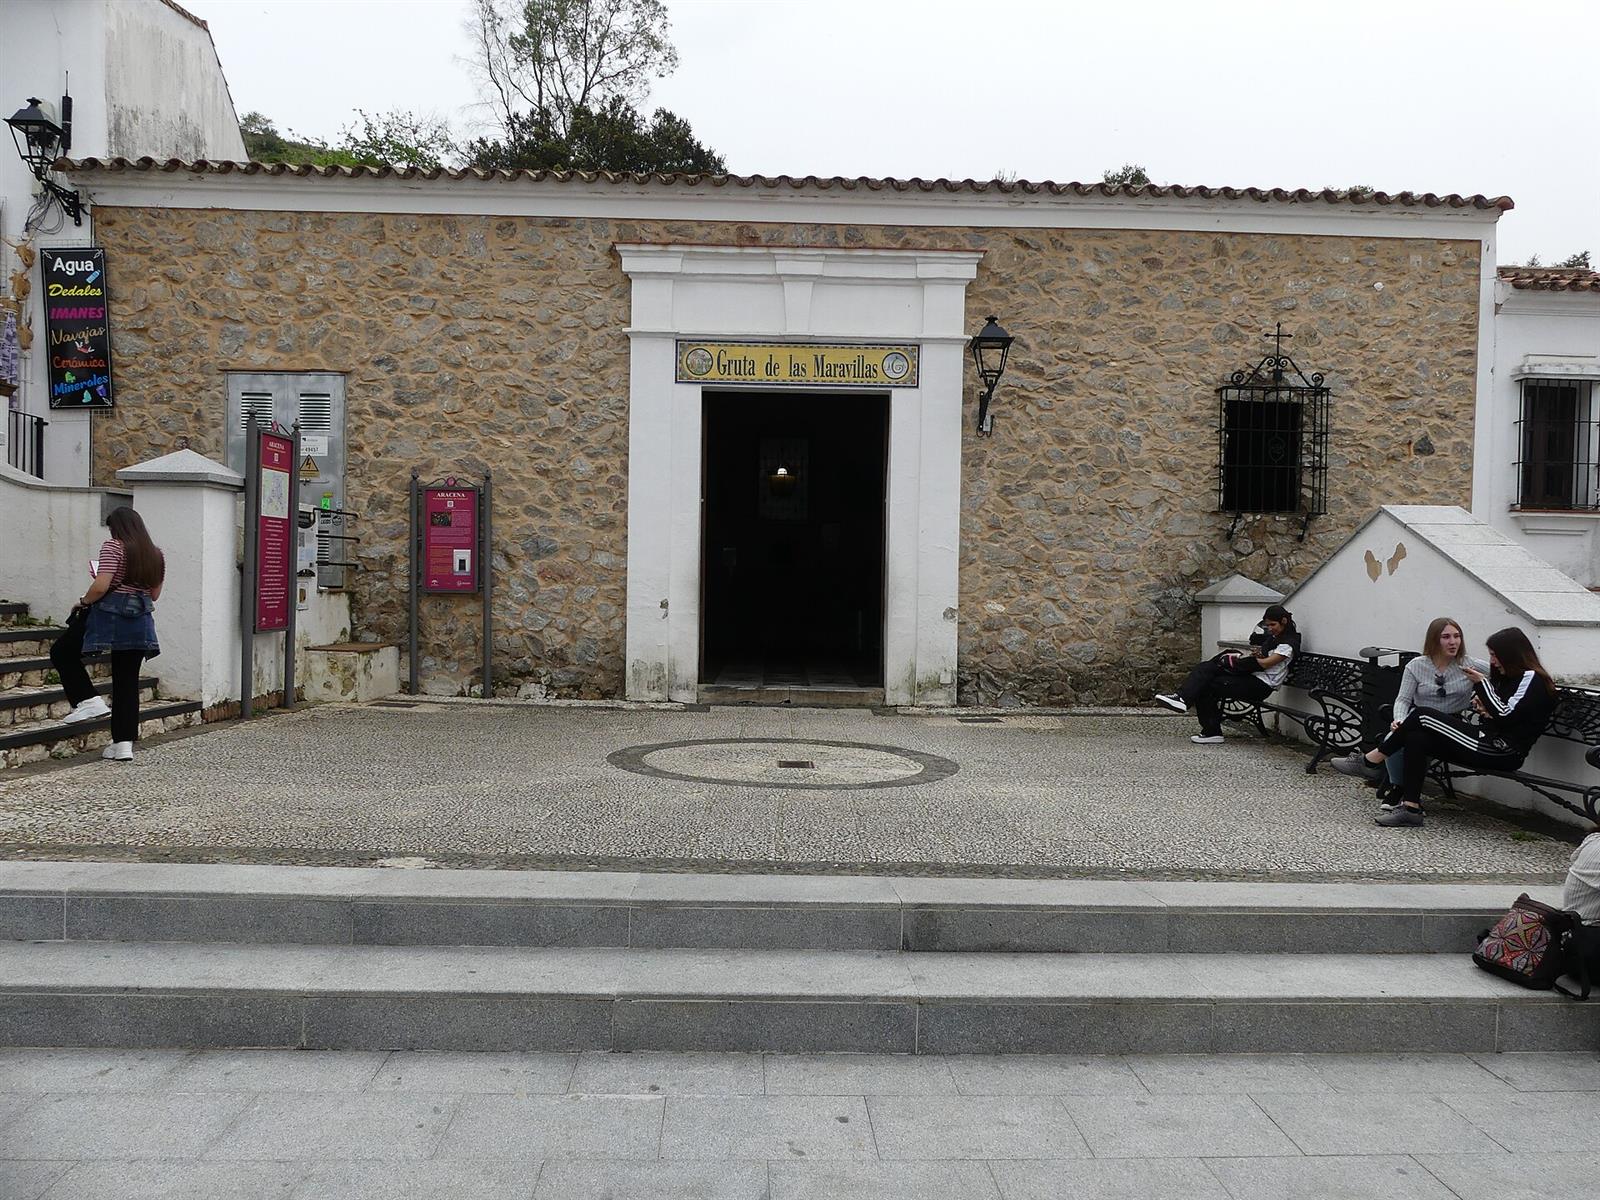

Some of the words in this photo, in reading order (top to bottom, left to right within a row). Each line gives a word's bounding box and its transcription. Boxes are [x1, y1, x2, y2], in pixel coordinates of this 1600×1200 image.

[53, 257, 95, 276] Agua
[48, 284, 103, 297] Dedales
[50, 307, 104, 319] IMANES
[51, 326, 106, 346] Navajas
[717, 349, 756, 376] Gruta
[765, 354, 780, 377] de
[788, 354, 807, 378] las
[813, 354, 878, 378] Maravillas
[54, 373, 109, 396] Minerales
